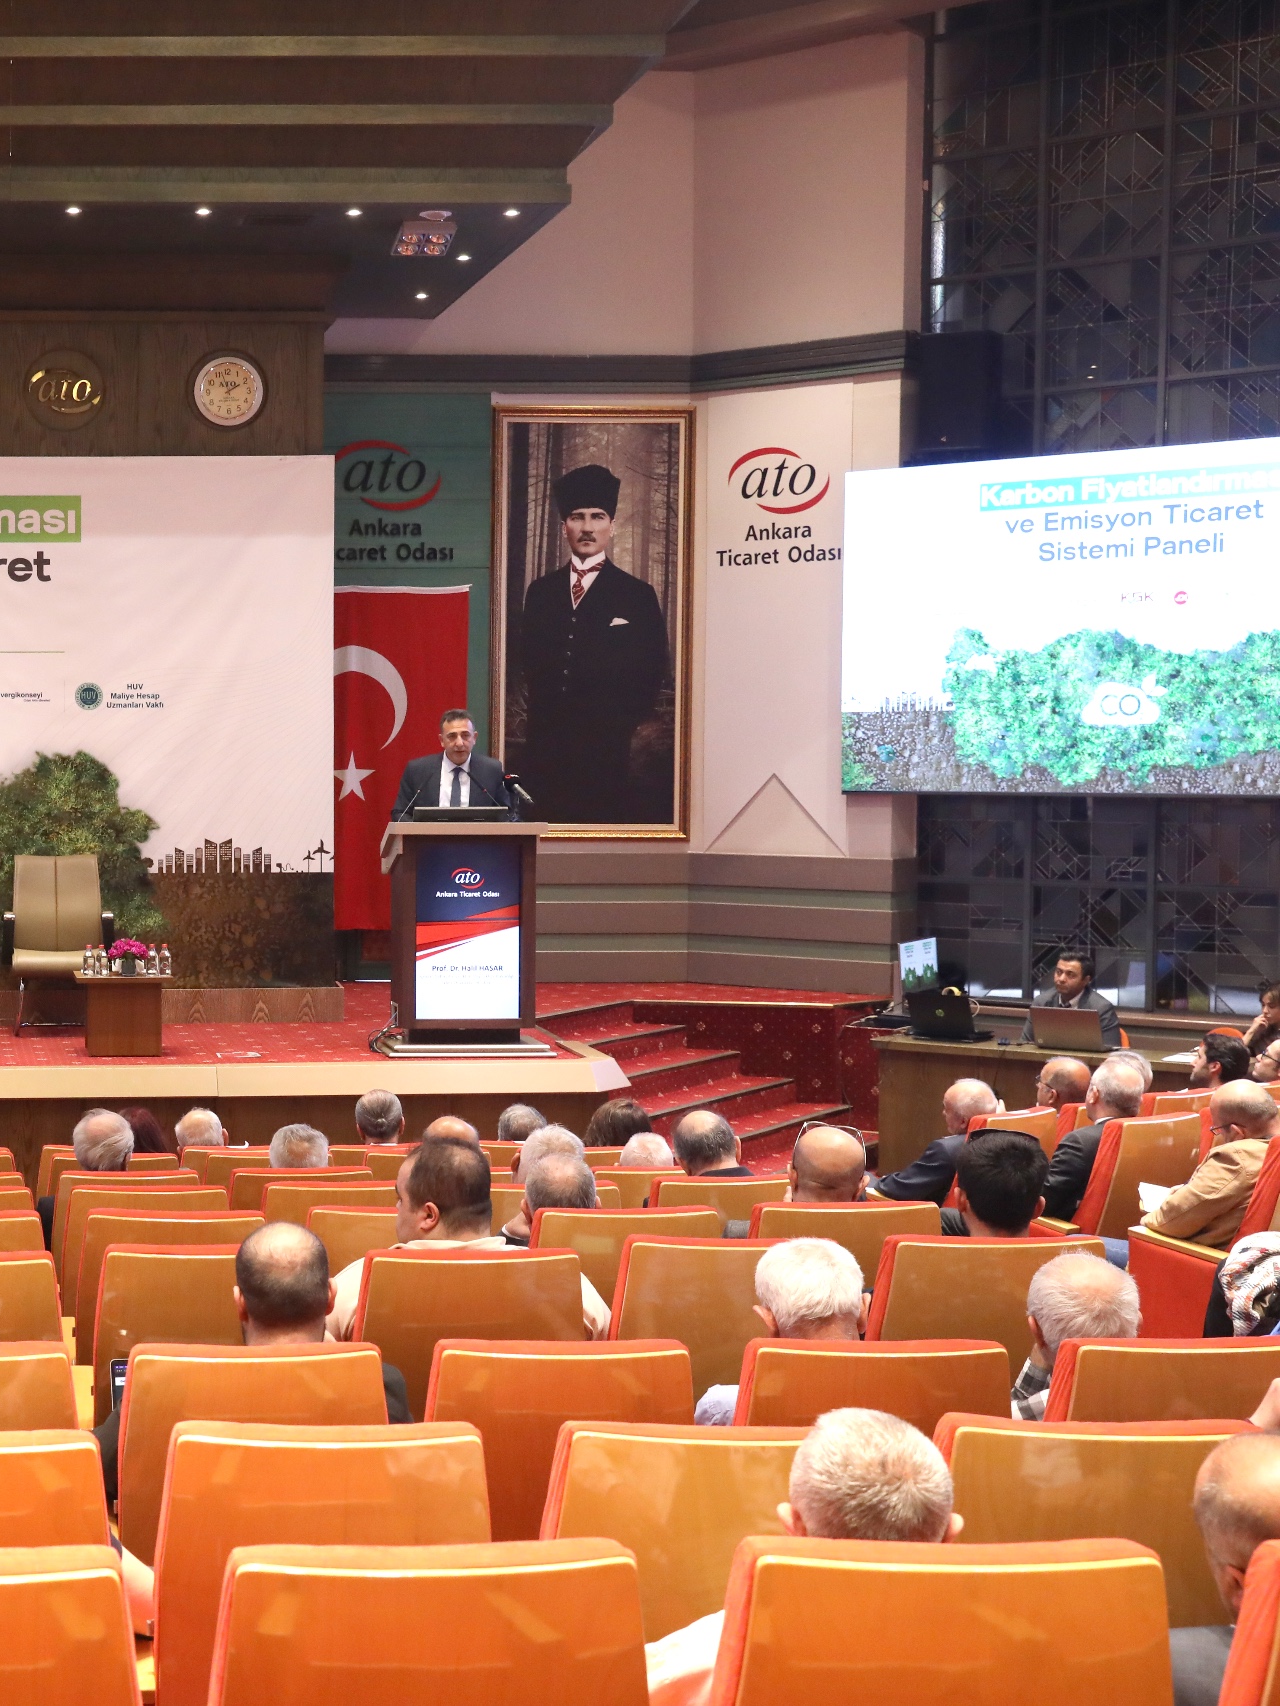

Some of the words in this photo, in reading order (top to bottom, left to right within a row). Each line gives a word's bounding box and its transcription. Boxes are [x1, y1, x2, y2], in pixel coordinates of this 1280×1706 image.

[343, 452, 426, 493] ato
[741, 457, 816, 499] ato
[981, 484, 1074, 507] Karbon
[1081, 469, 1280, 503] Fiyatlandırmas
[1005, 516, 1035, 534] ve
[1044, 509, 1152, 532] Emisyon
[1163, 499, 1264, 524] Ticaret
[349, 518, 422, 537] Ankara
[745, 522, 812, 541] Ankara
[334, 545, 387, 561] caret
[396, 542, 454, 562] Odası
[716, 549, 779, 567] Ticaret
[788, 544, 842, 563] Odası
[1039, 538, 1134, 562] Sistemi
[1145, 532, 1224, 556] Paneli
[0, 691, 43, 699] vergikonseyi
[110, 692, 135, 700] Maliye
[136, 692, 160, 701] Hesap
[455, 871, 480, 884] ato
